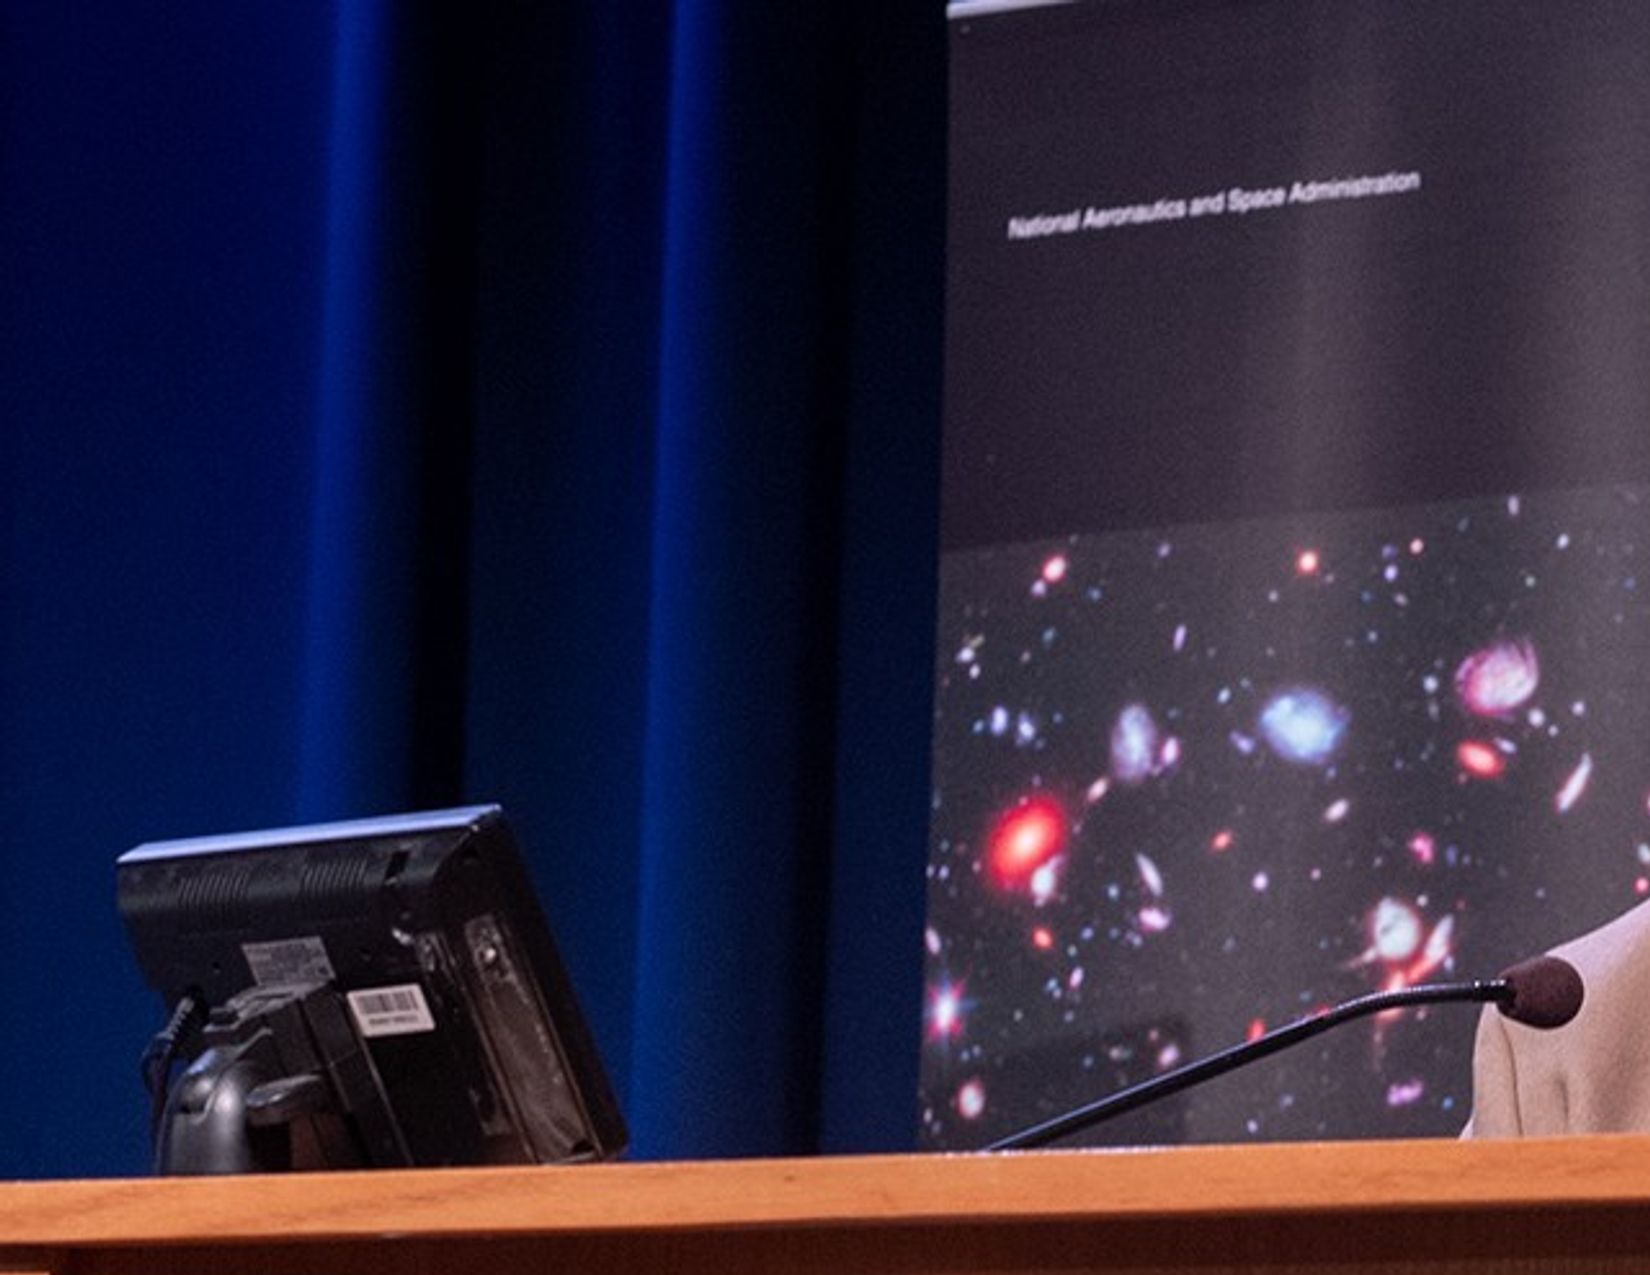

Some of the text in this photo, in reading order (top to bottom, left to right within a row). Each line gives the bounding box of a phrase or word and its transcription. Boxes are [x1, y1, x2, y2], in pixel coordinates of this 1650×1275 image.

[1008, 170, 1421, 240] National Aeronautics and Space Administration
